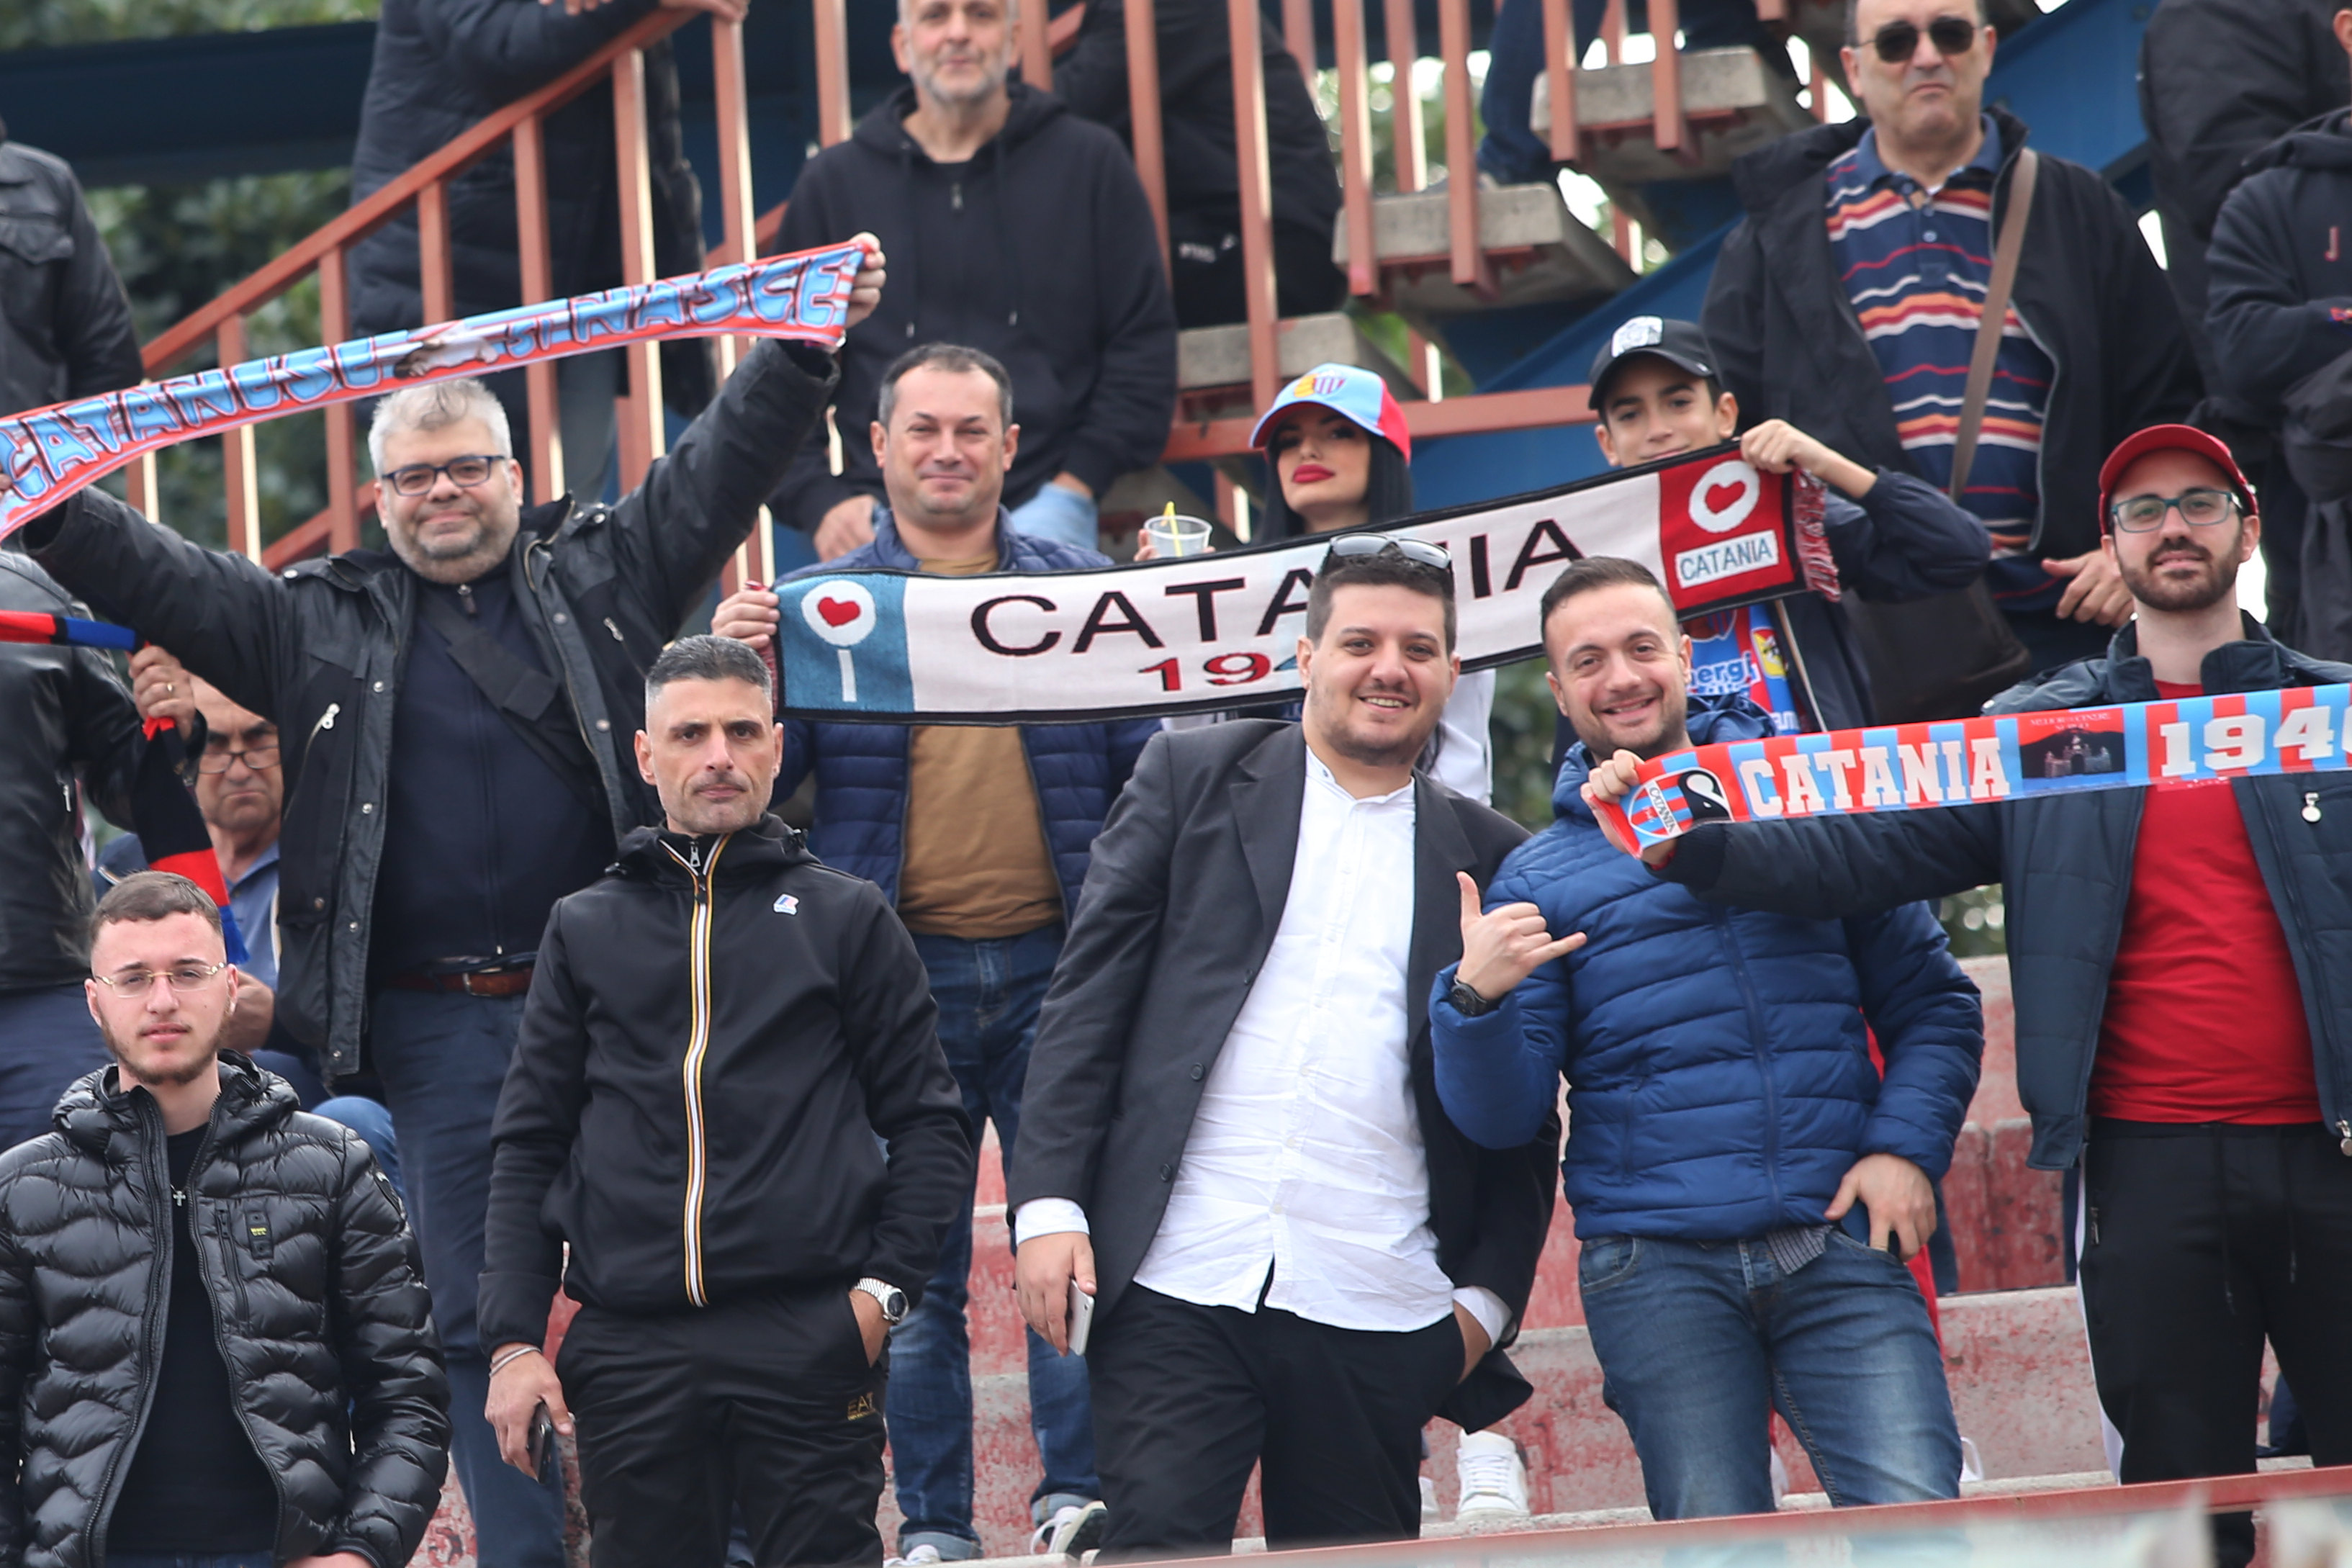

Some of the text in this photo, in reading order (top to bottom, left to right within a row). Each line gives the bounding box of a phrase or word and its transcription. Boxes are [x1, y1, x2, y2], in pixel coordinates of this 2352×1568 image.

[506, 316, 552, 359] SI
[569, 246, 852, 343] NASCE
[970, 518, 1586, 657] CATAIA
[1680, 538, 1772, 580] CATANIA
[1739, 737, 2011, 818] CATANIA
[2159, 704, 2352, 777] 194
[1649, 787, 1677, 832] CATANIA
